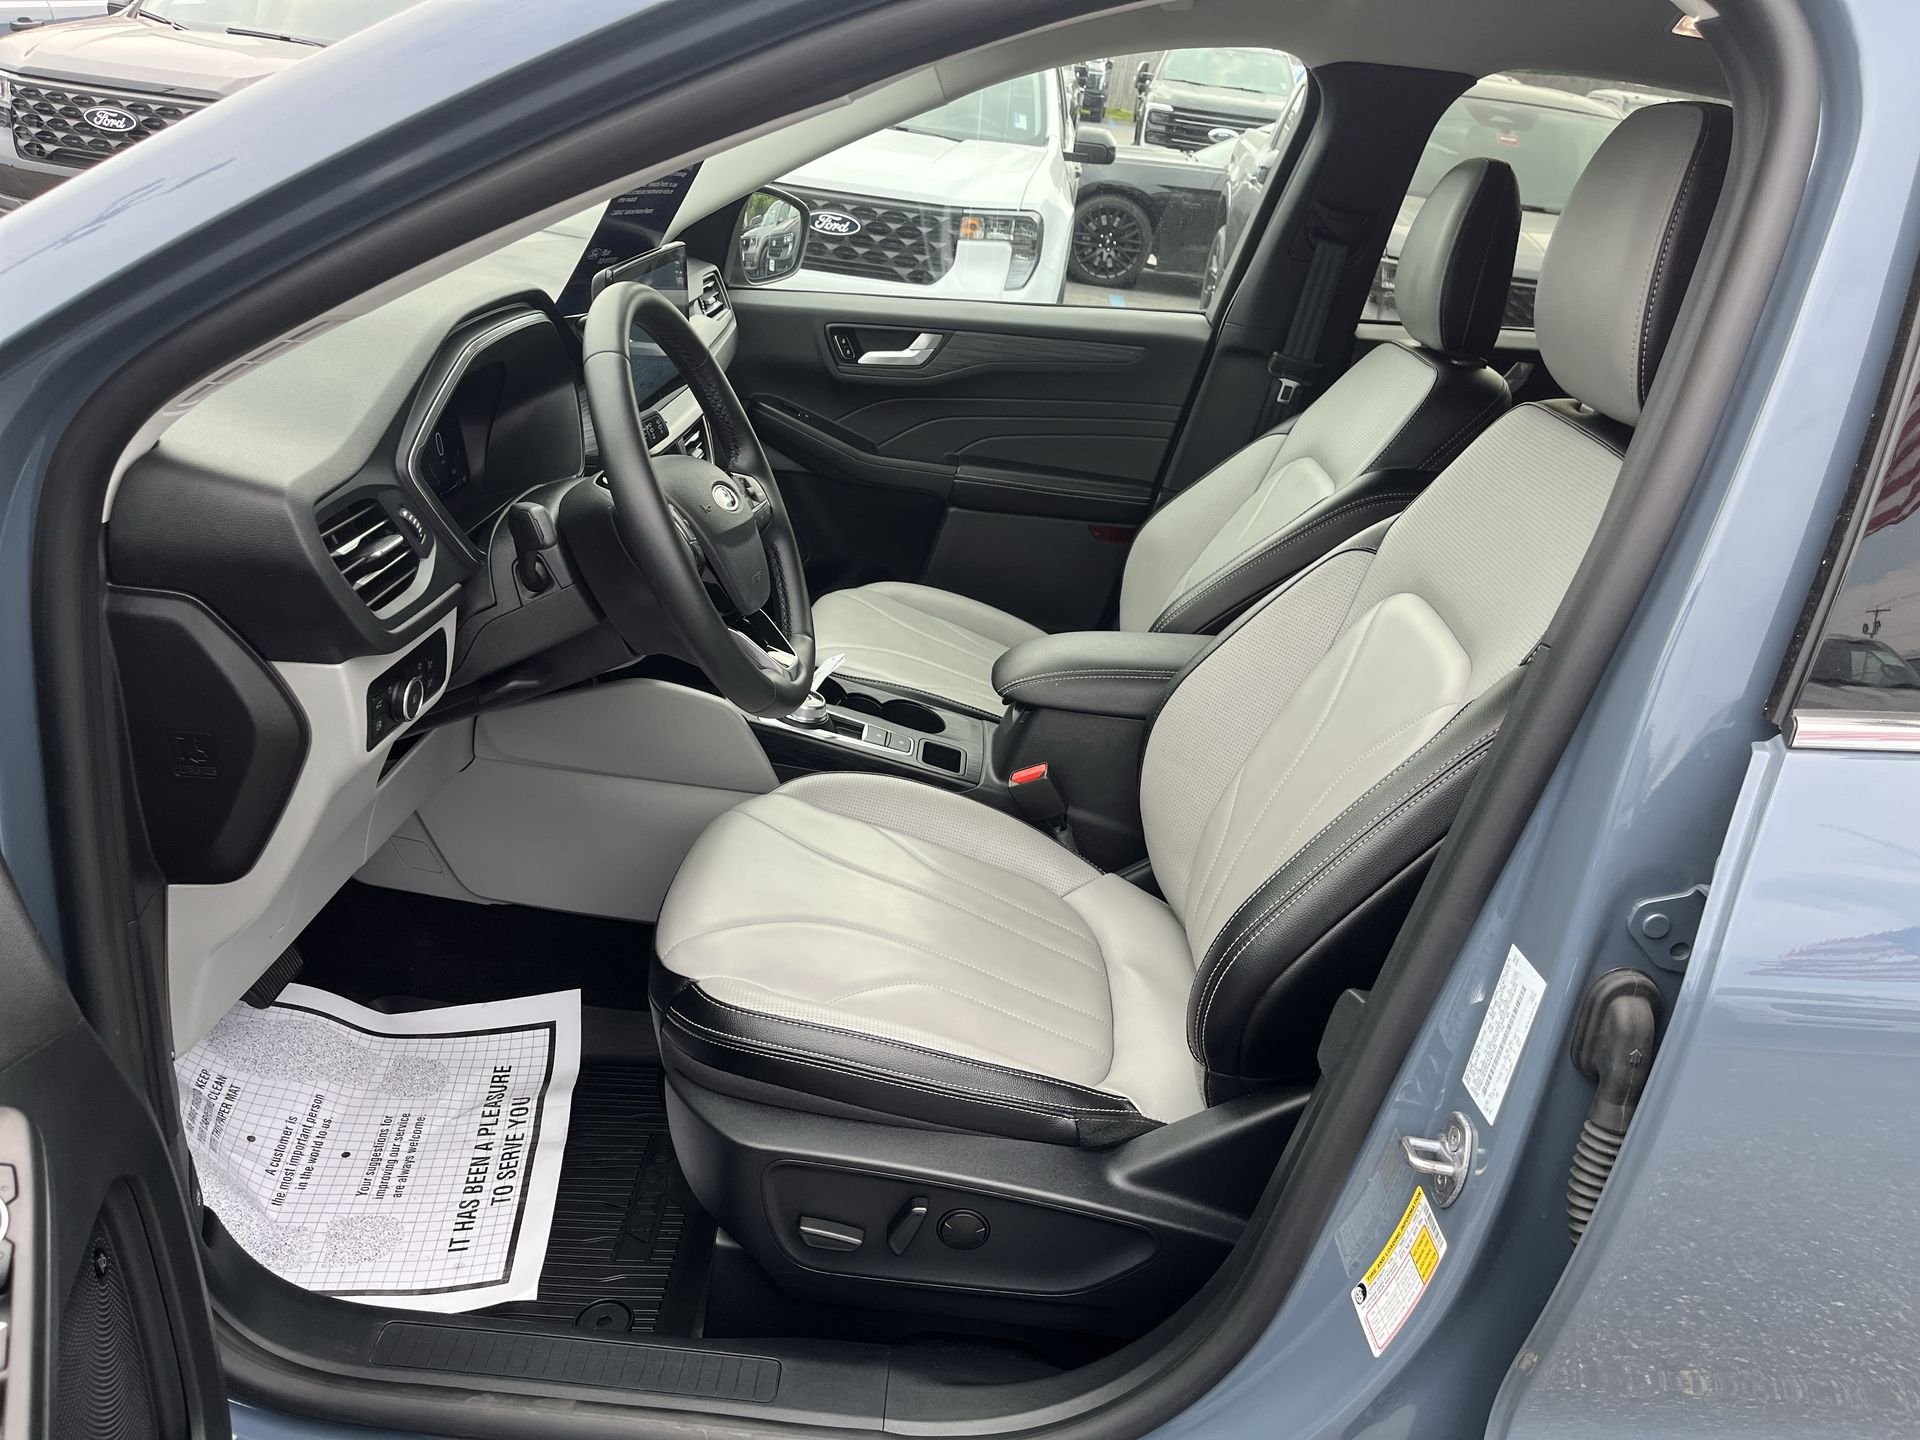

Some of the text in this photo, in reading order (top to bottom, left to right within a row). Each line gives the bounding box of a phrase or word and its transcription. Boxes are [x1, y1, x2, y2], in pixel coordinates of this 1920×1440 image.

[93, 110, 126, 129] Ford
[814, 214, 851, 232] Ford
[195, 1068, 211, 1090] KEEP
[207, 1074, 228, 1101] CLEAN
[224, 1083, 241, 1102] MAT
[270, 1126, 294, 1168] customer
[285, 1116, 298, 1125] is
[271, 1094, 325, 1206] the most important person
[294, 1117, 333, 1190] in the world to us.
[356, 1115, 394, 1197] Your suggestions for
[372, 1113, 411, 1200] improving our service
[448, 1065, 512, 1253] IT HAS BEEN A PLEASURE
[490, 1097, 531, 1206] TO SERVE YOU
[393, 1185, 405, 1198] are
[397, 1155, 416, 1183] always
[1366, 1270, 1377, 1282] TIRE
[1377, 1256, 1386, 1268] AND
[1385, 1231, 1401, 1257] LOADING
[1400, 1191, 1422, 1232] INFORMATION
